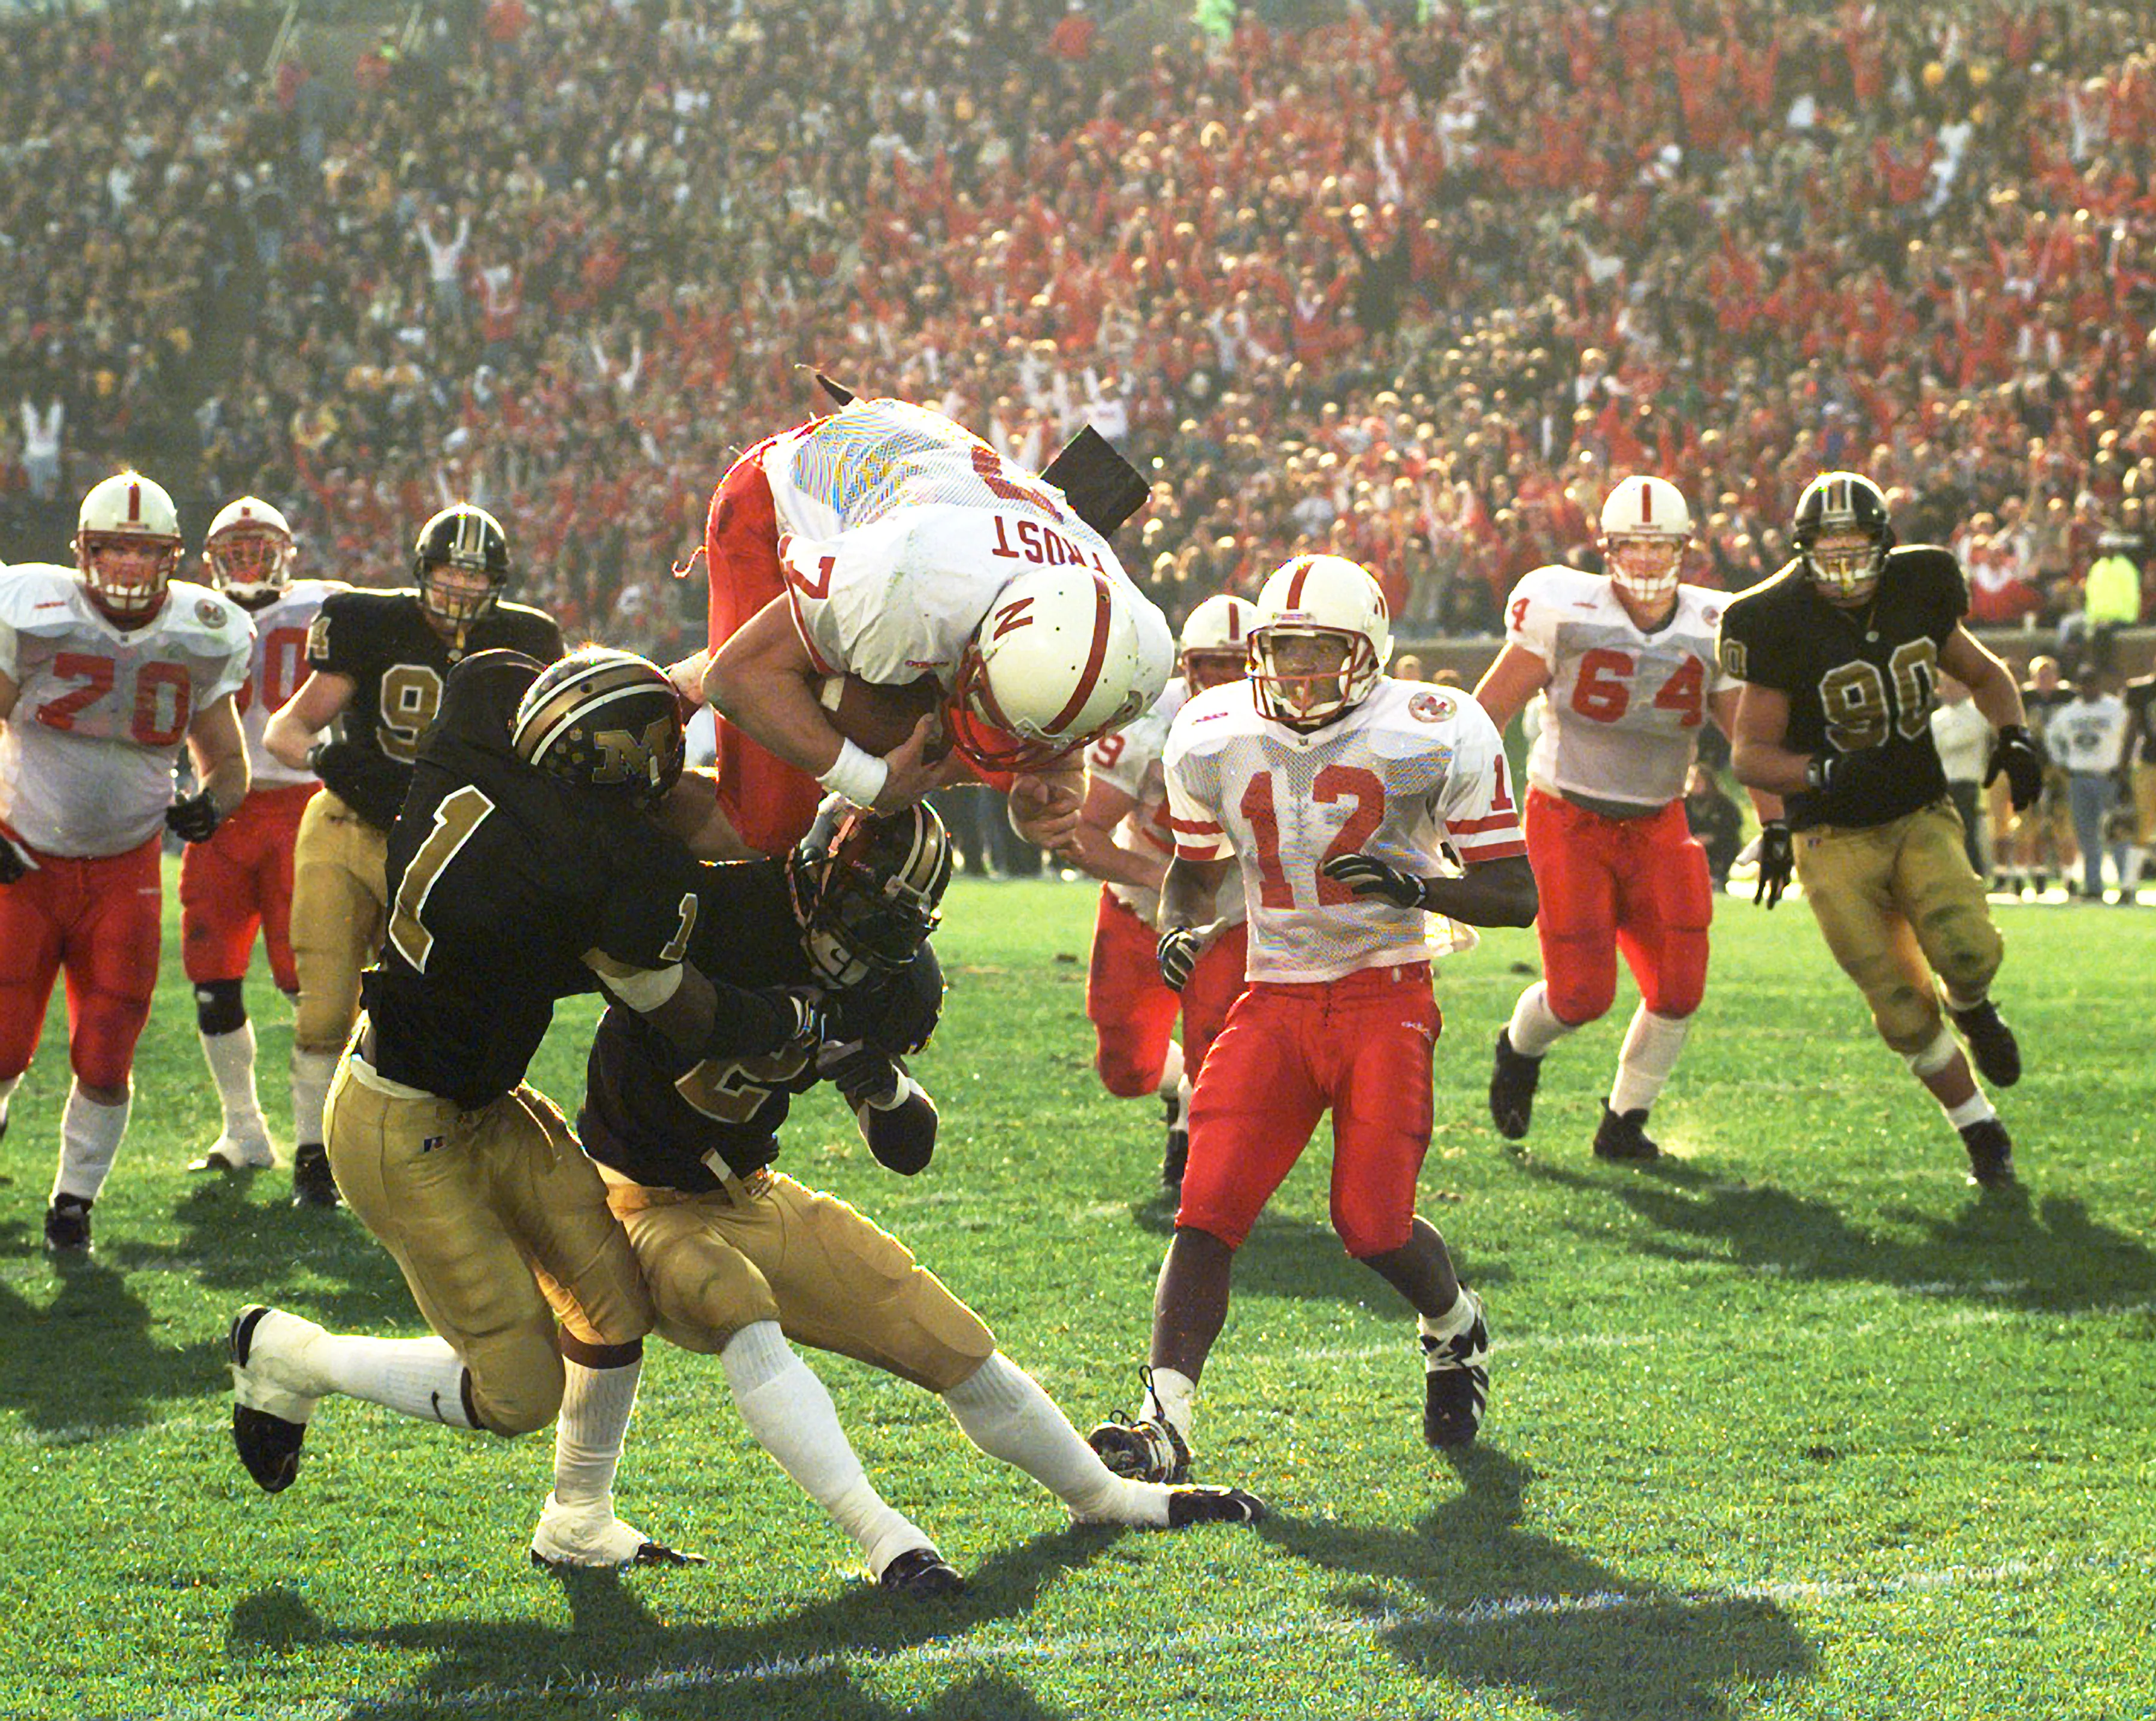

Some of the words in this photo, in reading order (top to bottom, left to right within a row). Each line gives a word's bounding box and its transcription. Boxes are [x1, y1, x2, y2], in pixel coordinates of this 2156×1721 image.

[785, 556, 835, 600] 7
[993, 597, 1034, 642] N
[236, 627, 313, 716] 0
[1571, 648, 1704, 727] 64
[1819, 636, 1937, 752] 90
[592, 715, 672, 785] M
[1490, 754, 1513, 811] 1
[1240, 764, 1385, 911] 12
[389, 784, 496, 975] 1
[659, 893, 698, 962] 1
